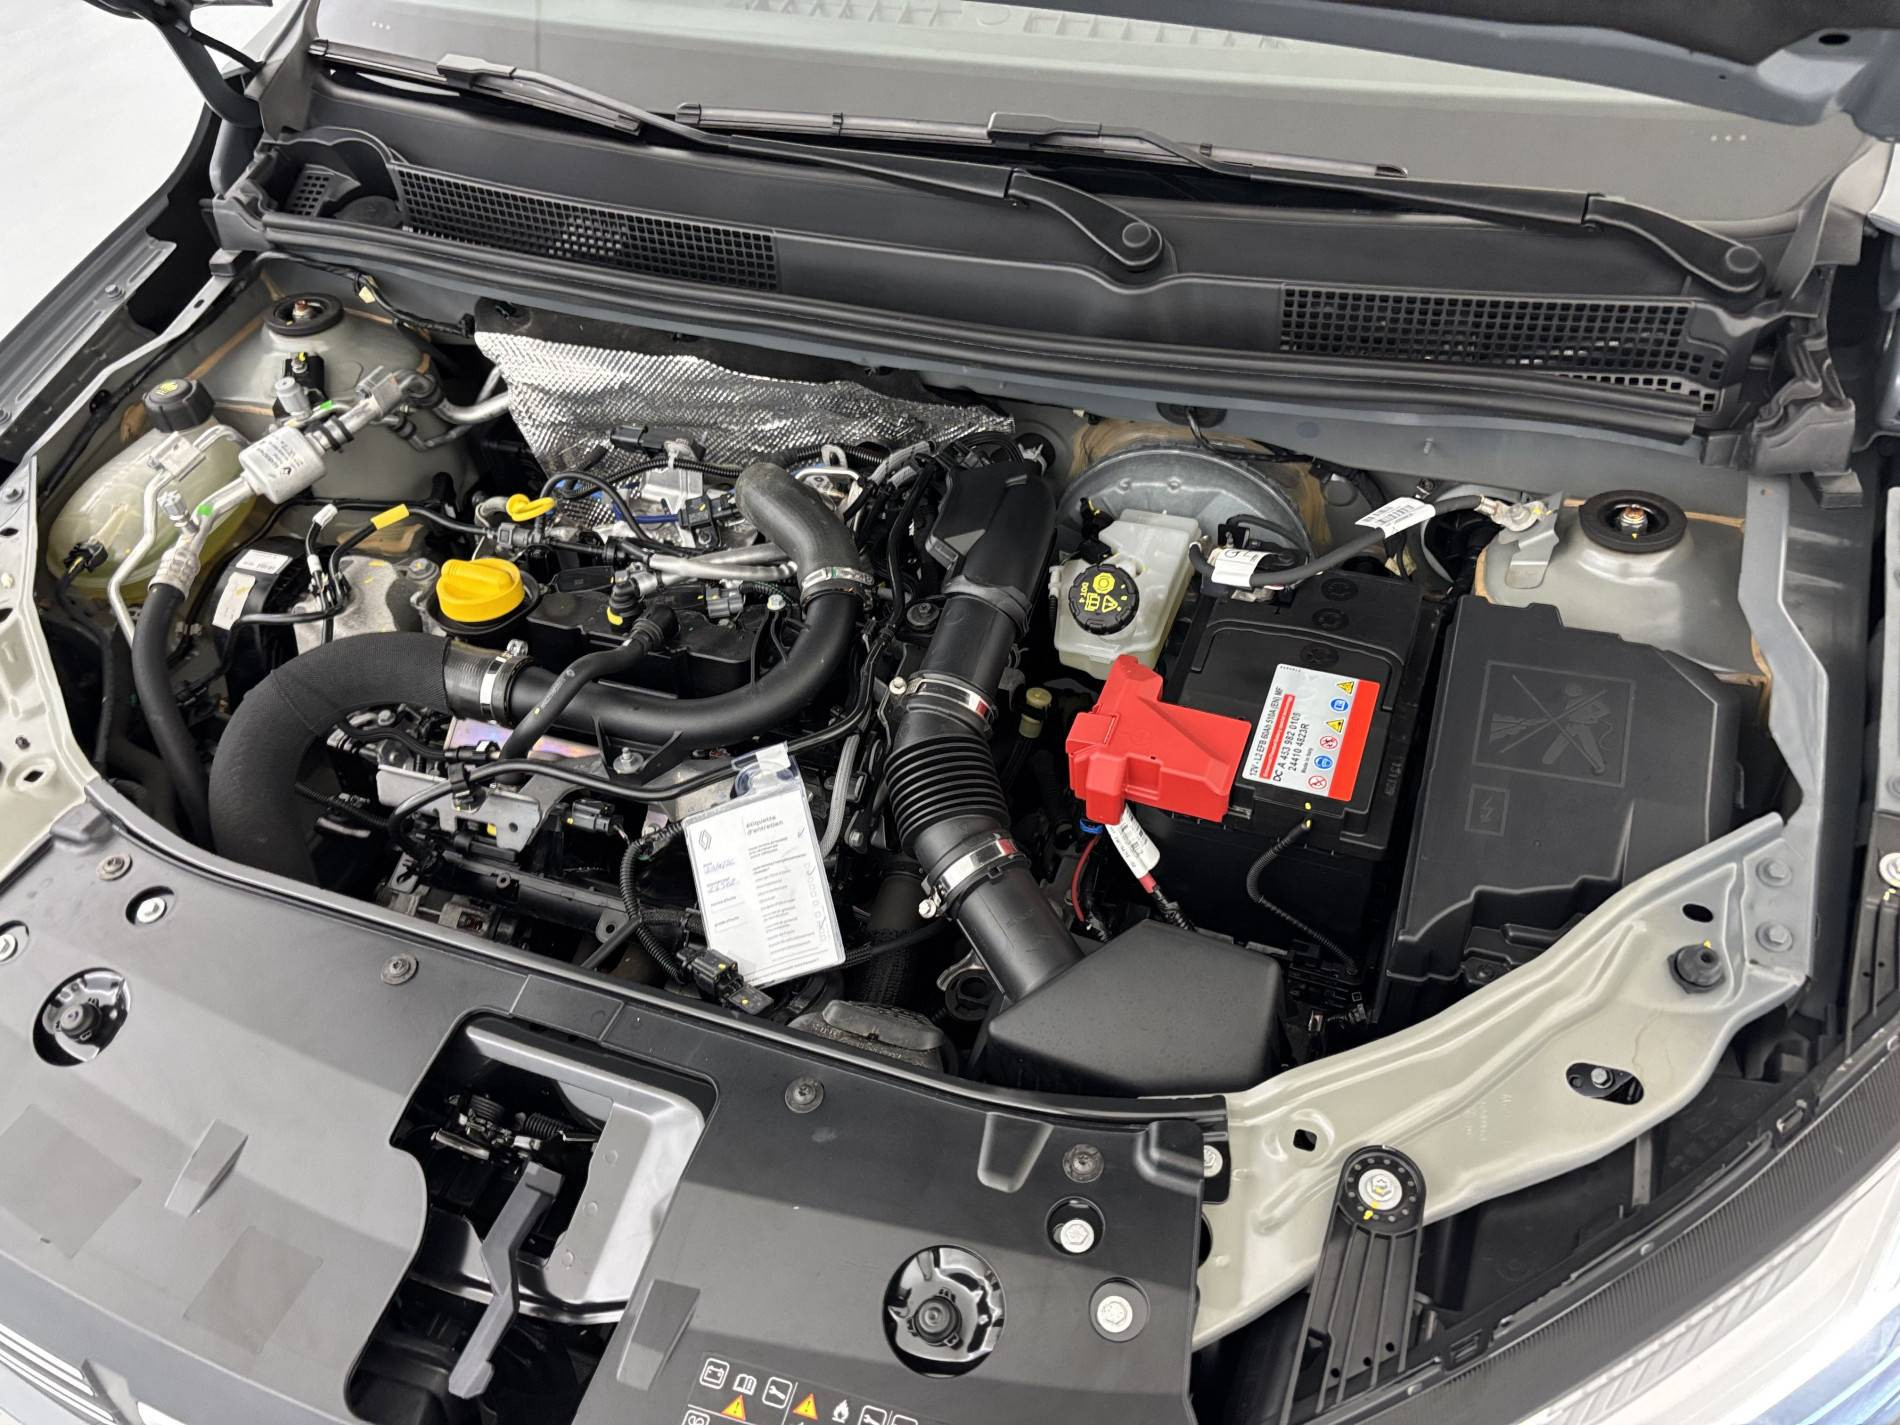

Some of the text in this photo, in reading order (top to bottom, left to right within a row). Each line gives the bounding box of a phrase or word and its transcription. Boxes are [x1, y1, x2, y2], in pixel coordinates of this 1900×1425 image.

[1080, 582, 1089, 597] DOT
[1270, 696, 1280, 709] (EN)
[1266, 708, 1276, 724] 510A
[1261, 724, 1272, 739] 60Ah
[1284, 730, 1295, 745] 982
[1256, 739, 1266, 752] EFB
[1254, 752, 1262, 761] L2
[1280, 746, 1290, 760] 453
[1288, 748, 1302, 772] 24410
[1249, 764, 1258, 776] 12V
[1273, 769, 1283, 782] DC
